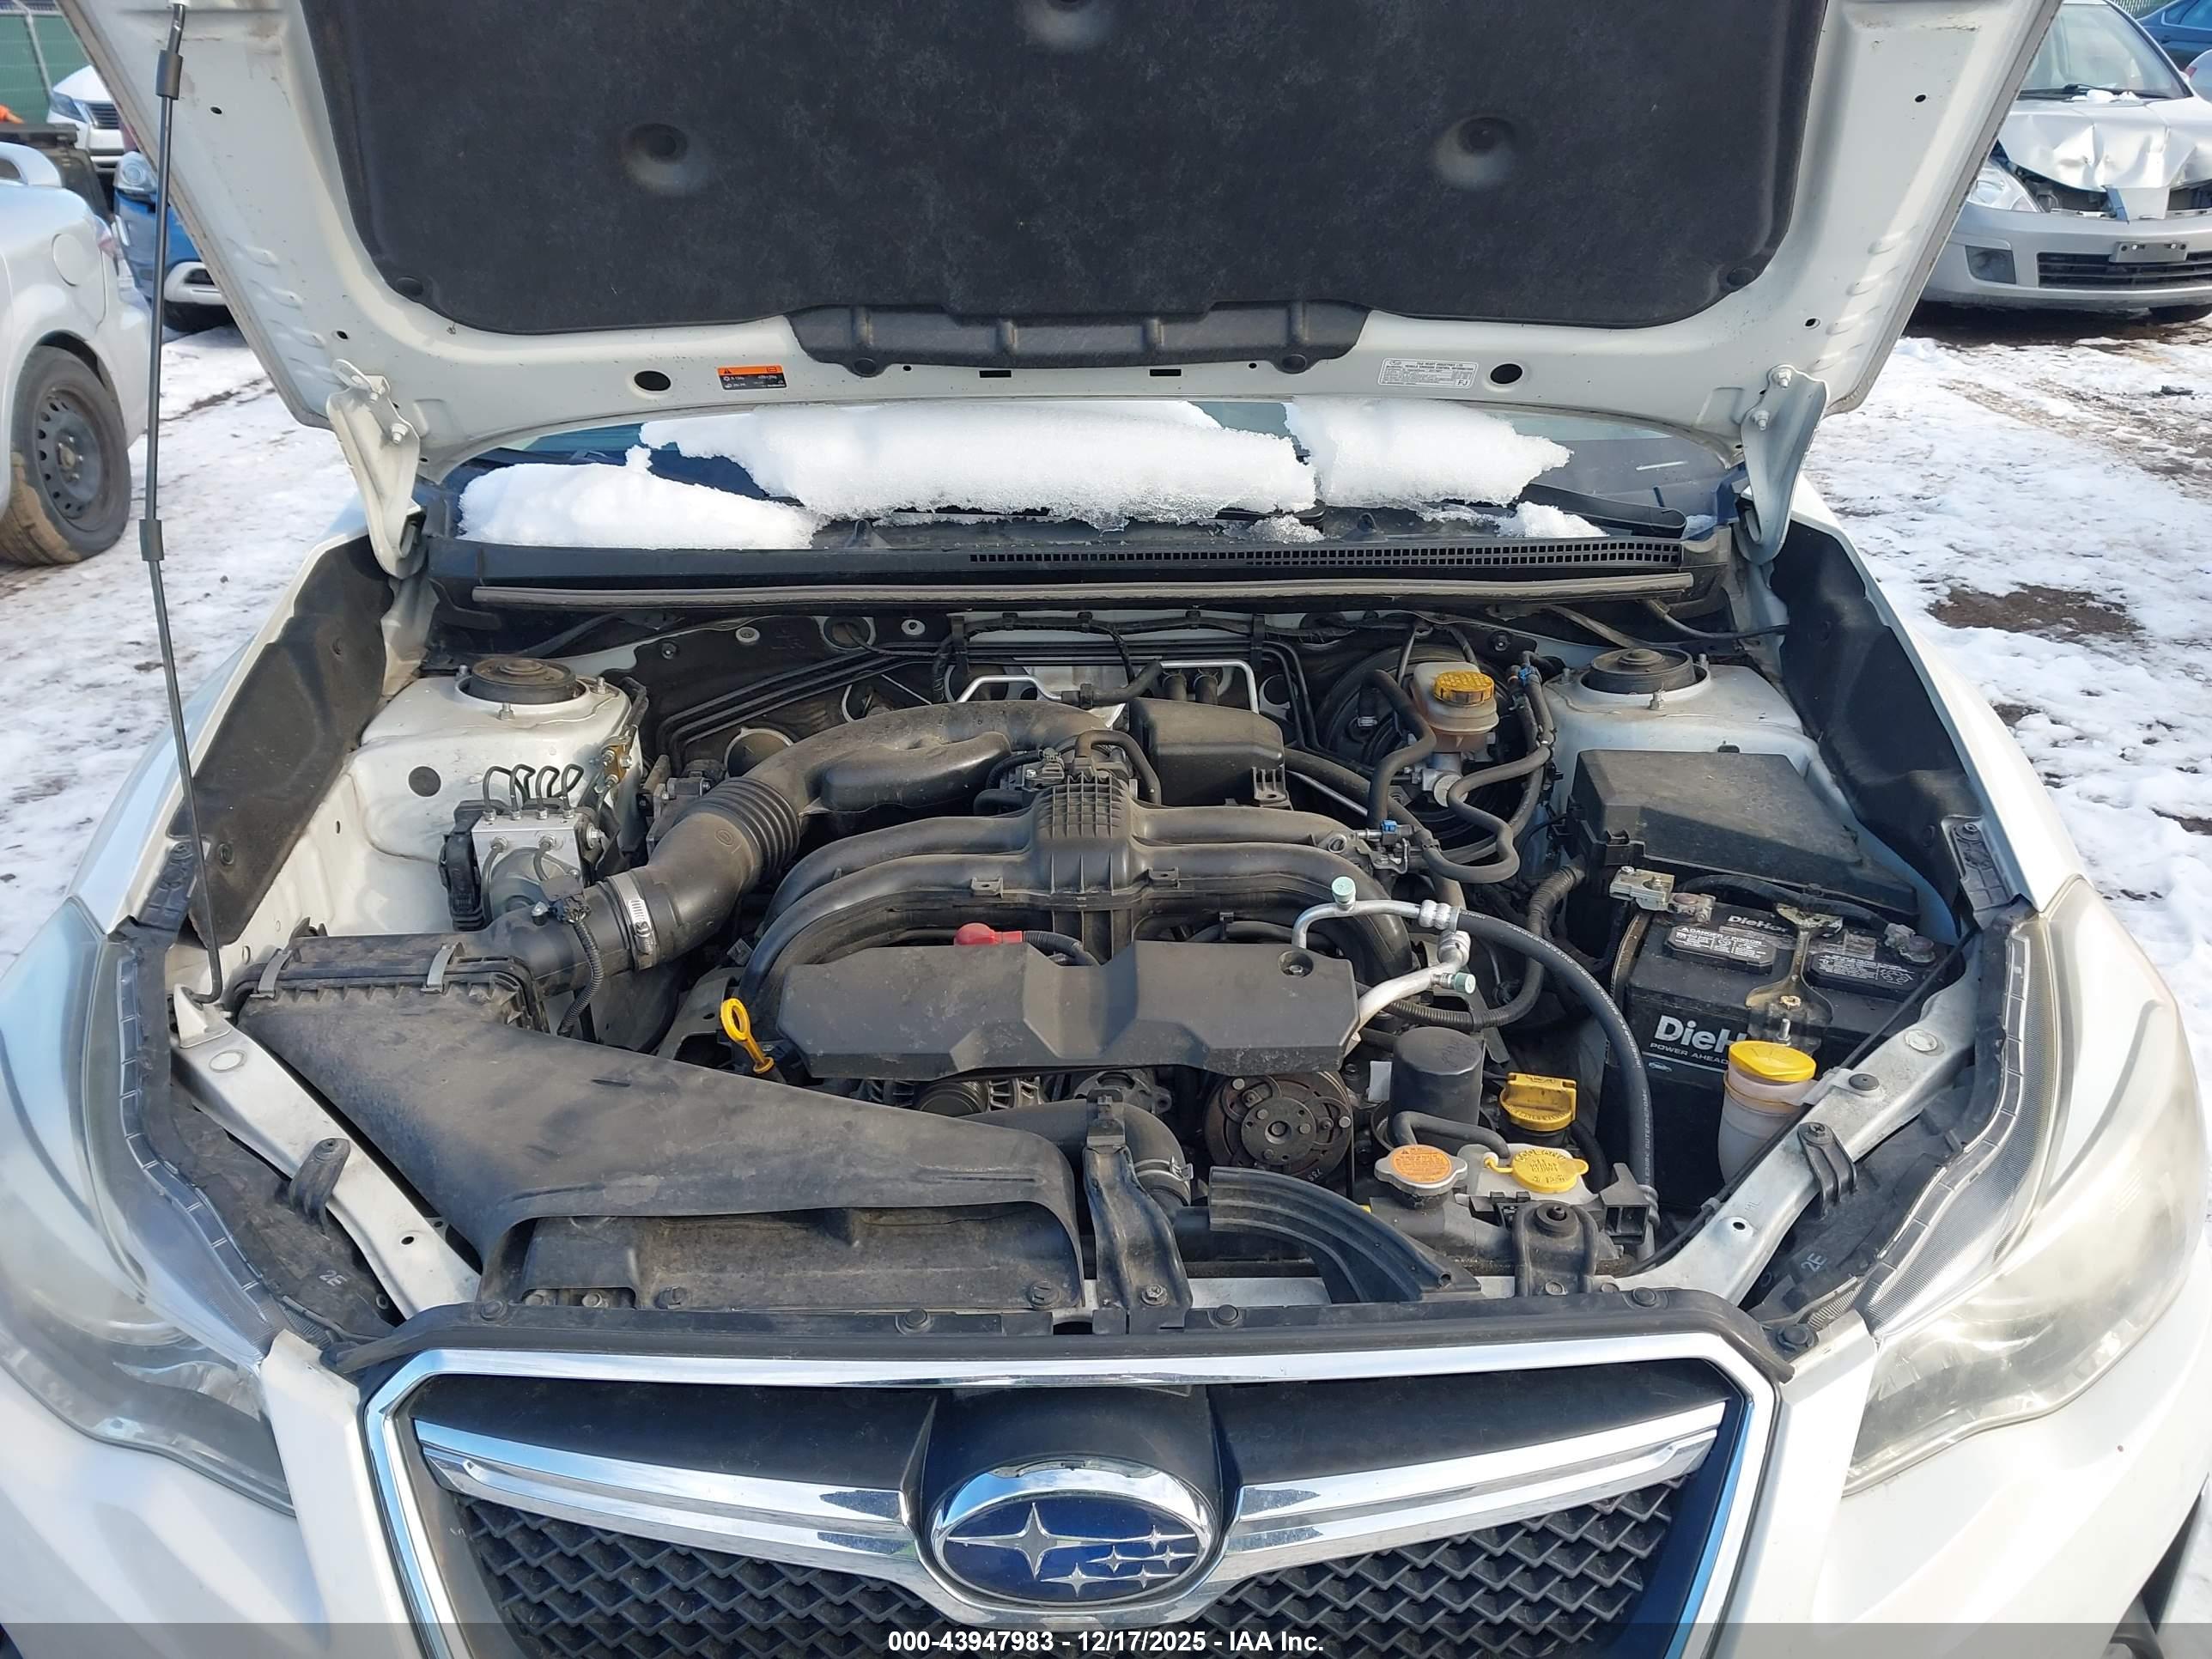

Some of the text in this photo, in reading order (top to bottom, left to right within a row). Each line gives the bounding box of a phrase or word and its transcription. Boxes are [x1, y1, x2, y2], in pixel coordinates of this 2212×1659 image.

[1727, 915, 1789, 933] DieHar
[1654, 1014, 1747, 1054] DieH
[1650, 1042, 1729, 1066] POWER AHEAD
[1801, 1253, 1827, 1272] 2E
[319, 1270, 347, 1286] 2E
